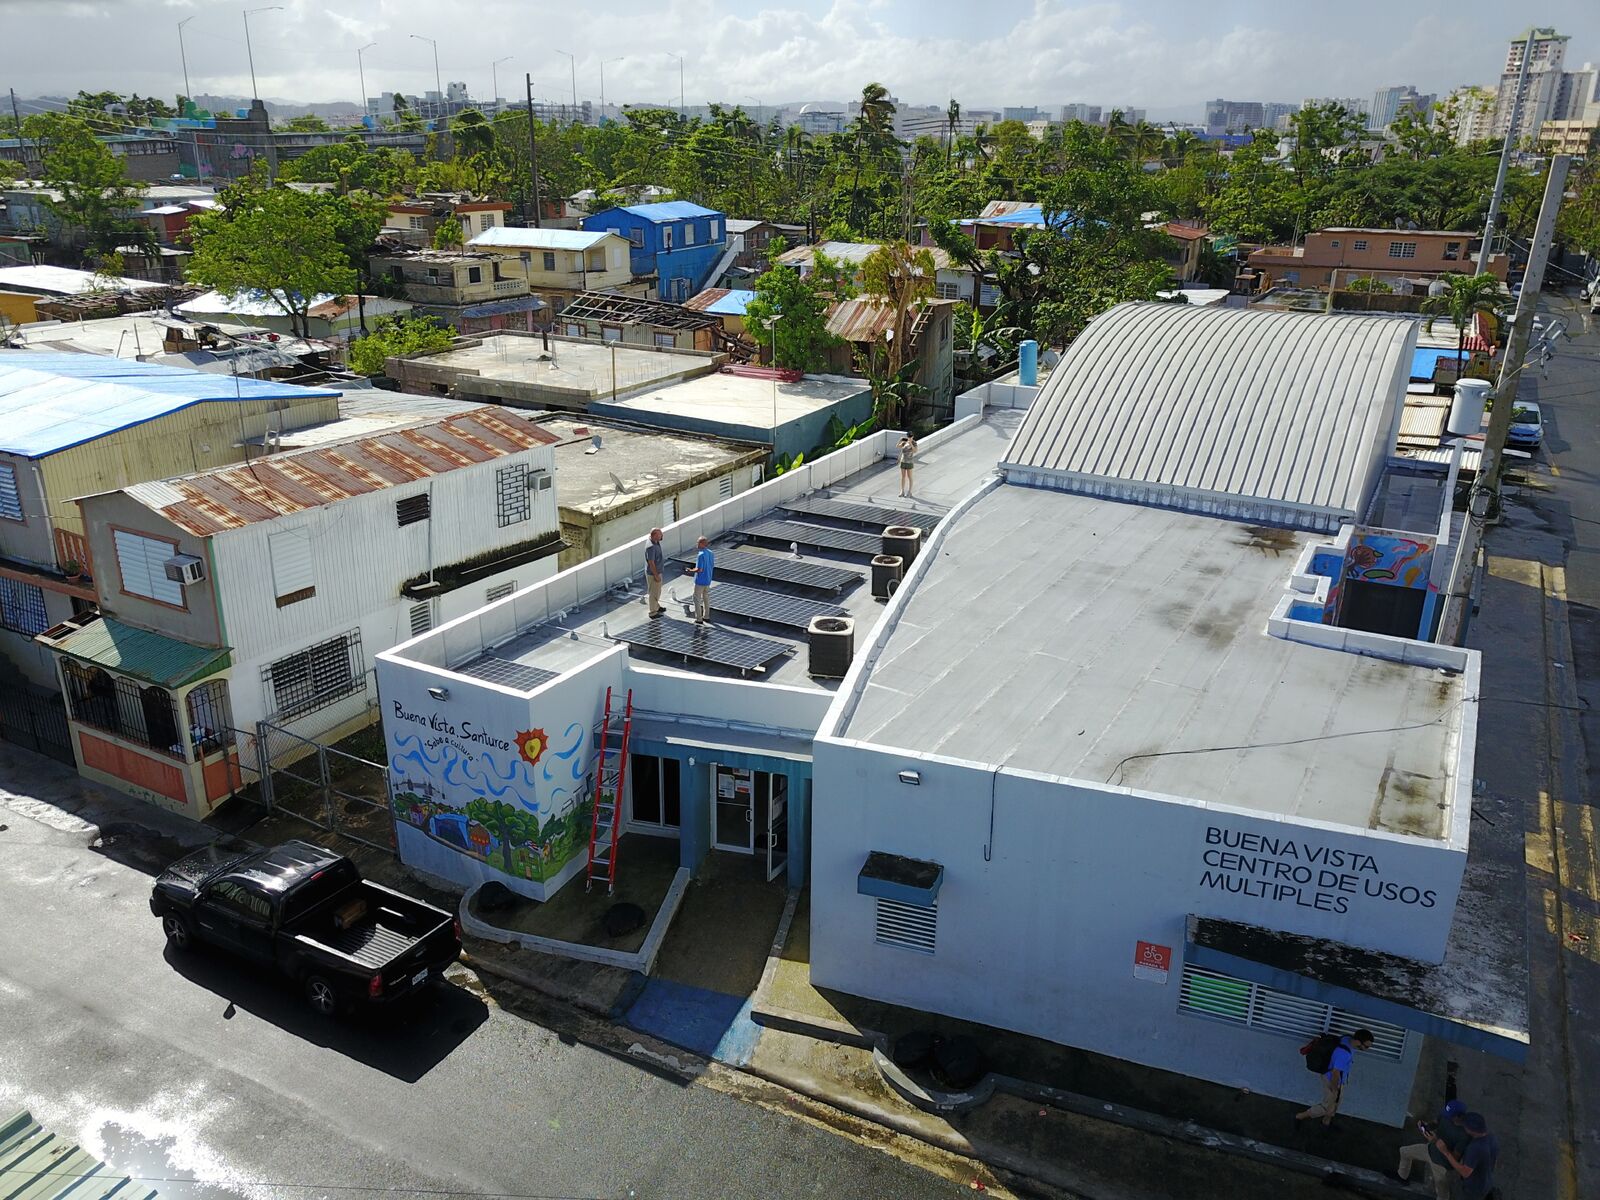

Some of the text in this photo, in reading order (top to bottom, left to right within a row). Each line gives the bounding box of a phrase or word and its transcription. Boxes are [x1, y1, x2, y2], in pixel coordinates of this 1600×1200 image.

[393, 700, 426, 726] Buena
[460, 722, 510, 752] Santurce
[1205, 826, 1379, 874] BUENA VISTA
[1199, 870, 1350, 914] MULTIPLES
[1202, 849, 1437, 908] CENTRO DE USOS
